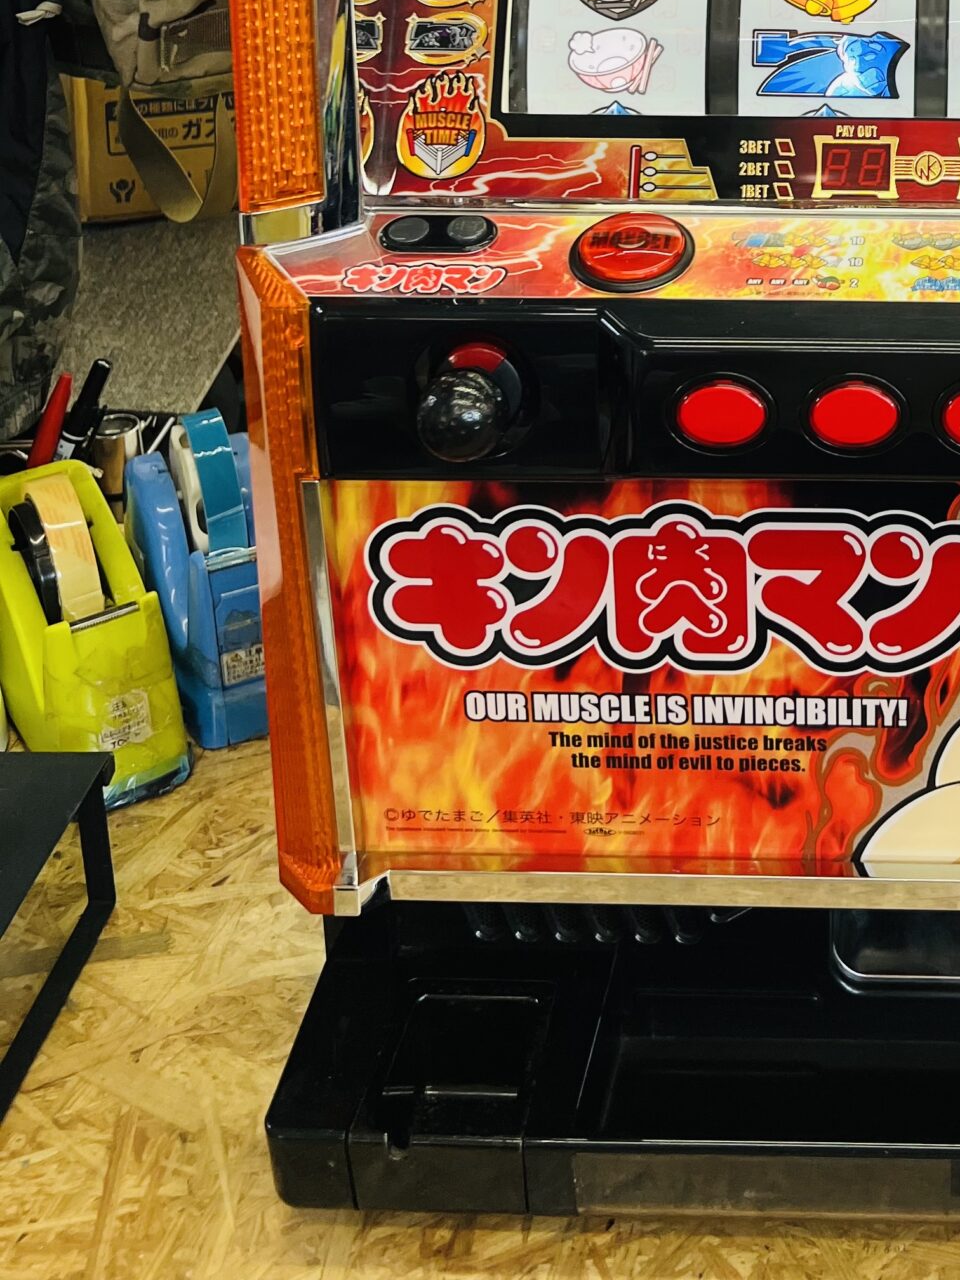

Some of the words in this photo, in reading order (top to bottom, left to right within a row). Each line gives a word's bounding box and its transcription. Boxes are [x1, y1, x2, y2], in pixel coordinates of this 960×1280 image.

[413, 111, 471, 129] MUSCLE
[423, 129, 461, 146] TIME
[836, 125, 856, 138] PAY
[857, 125, 878, 138] OUT
[739, 140, 771, 155] 3BET
[739, 162, 770, 177] 2BET
[740, 184, 770, 199] 1BET
[849, 236, 865, 246] 10
[847, 257, 864, 267] 10
[344, 263, 507, 295] キン肉マン
[849, 278, 859, 289] 2
[464, 691, 528, 721] OUR
[532, 692, 652, 723] MUSCLE
[656, 694, 689, 724] IS
[693, 696, 908, 727] INVINCIBILITY!
[549, 731, 583, 748] The
[587, 731, 635, 748] mind
[638, 732, 657, 749] of
[659, 733, 690, 750] the
[693, 734, 759, 752] justice
[763, 735, 827, 752] breaks
[571, 752, 602, 768] the
[606, 752, 653, 769] mind
[657, 753, 676, 769] of
[678, 754, 712, 770] evil
[716, 754, 735, 771] to
[740, 755, 806, 773] pieces.
